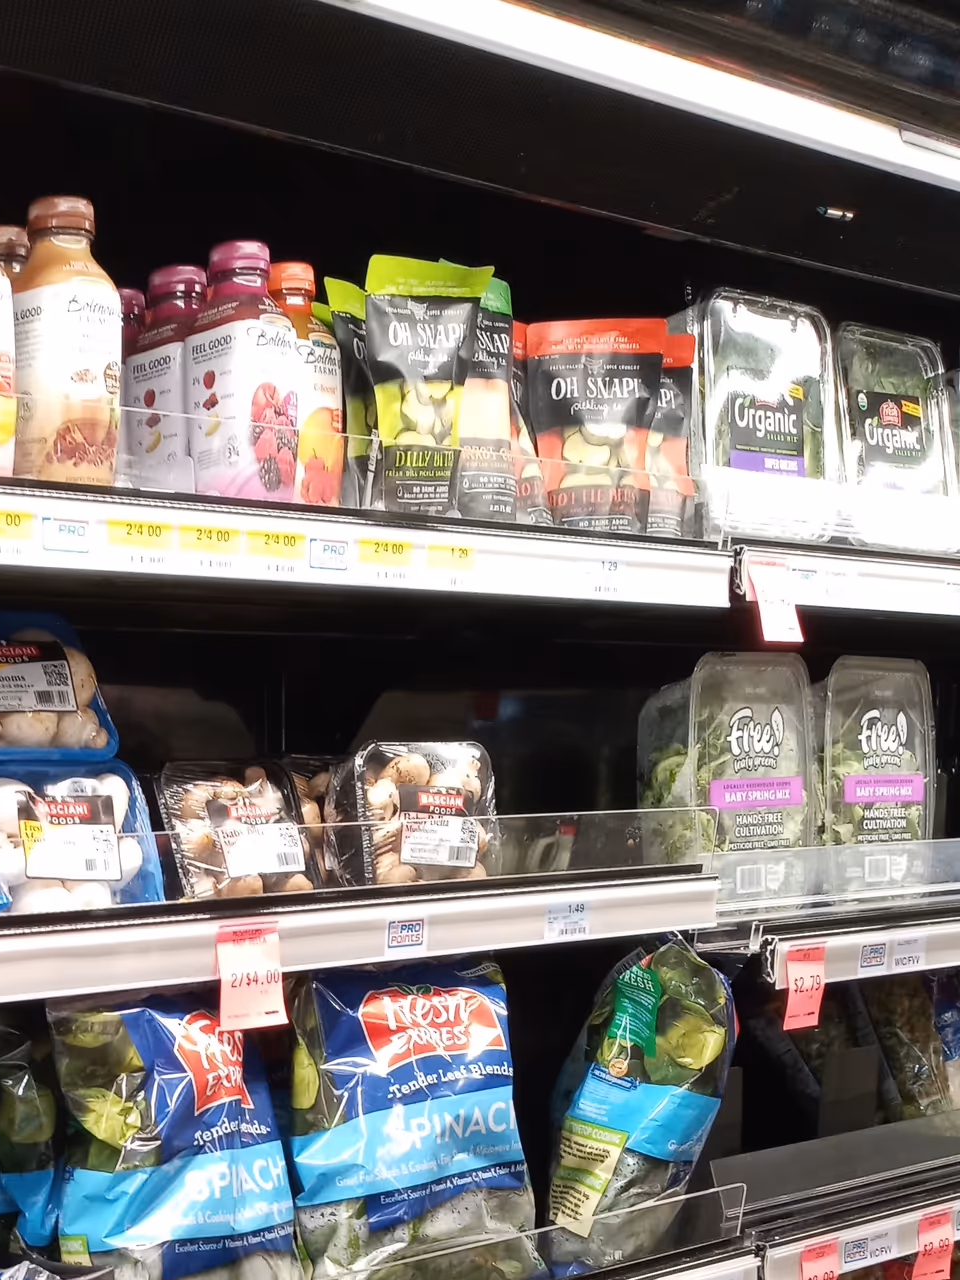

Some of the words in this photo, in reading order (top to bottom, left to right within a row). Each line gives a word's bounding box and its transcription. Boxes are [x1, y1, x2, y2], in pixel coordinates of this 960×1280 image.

[388, 321, 412, 346] OH
[417, 322, 466, 349] SNAP!
[192, 341, 208, 357] FEEL
[208, 334, 232, 350] GOOD
[132, 362, 148, 376] FEEL
[149, 356, 171, 371] GOOD
[551, 377, 578, 400] OH
[587, 377, 641, 399] SNAP!
[734, 397, 798, 437] Organic
[864, 418, 921, 453] Organic
[396, 450, 432, 467] DILLY
[58, 524, 86, 536] PRO
[323, 545, 345, 556] PRO
[726, 707, 785, 756] Free!
[857, 707, 908, 755] Free!
[734, 756, 753, 773] leafy
[754, 756, 777, 771] greens
[863, 757, 879, 770] leafy
[880, 756, 901, 769] greens
[725, 791, 746, 803] BABY
[748, 790, 775, 801] SPRING
[776, 789, 790, 800] MIX
[855, 786, 874, 797] BABY
[874, 786, 899, 797] SPRING
[900, 786, 913, 796] MIX
[430, 807, 456, 815] FOODS
[864, 808, 888, 819] HANDS
[889, 807, 906, 818] FREE
[46, 816, 80, 824] FOODS
[736, 813, 762, 825] HANDS
[764, 812, 783, 824] FREE
[863, 818, 907, 830] CULTIVATION
[735, 824, 784, 837] CULTIVATION
[728, 841, 753, 850] PESTICIDE
[753, 840, 765, 849] FREE
[568, 903, 585, 914] 1.49
[399, 923, 422, 934] PRO
[389, 933, 422, 945] POINTS
[868, 944, 884, 955] PRO
[894, 955, 920, 967] WIC/FVV
[231, 968, 280, 988] 2/$4.00
[794, 974, 821, 994] $2.79
[438, 1066, 468, 1082] Leaf
[380, 1190, 409, 1204] Excellent
[408, 1187, 426, 1200] Source
[175, 1240, 198, 1254] Excellent
[199, 1238, 217, 1251] Source
[851, 1241, 867, 1251] PRO
